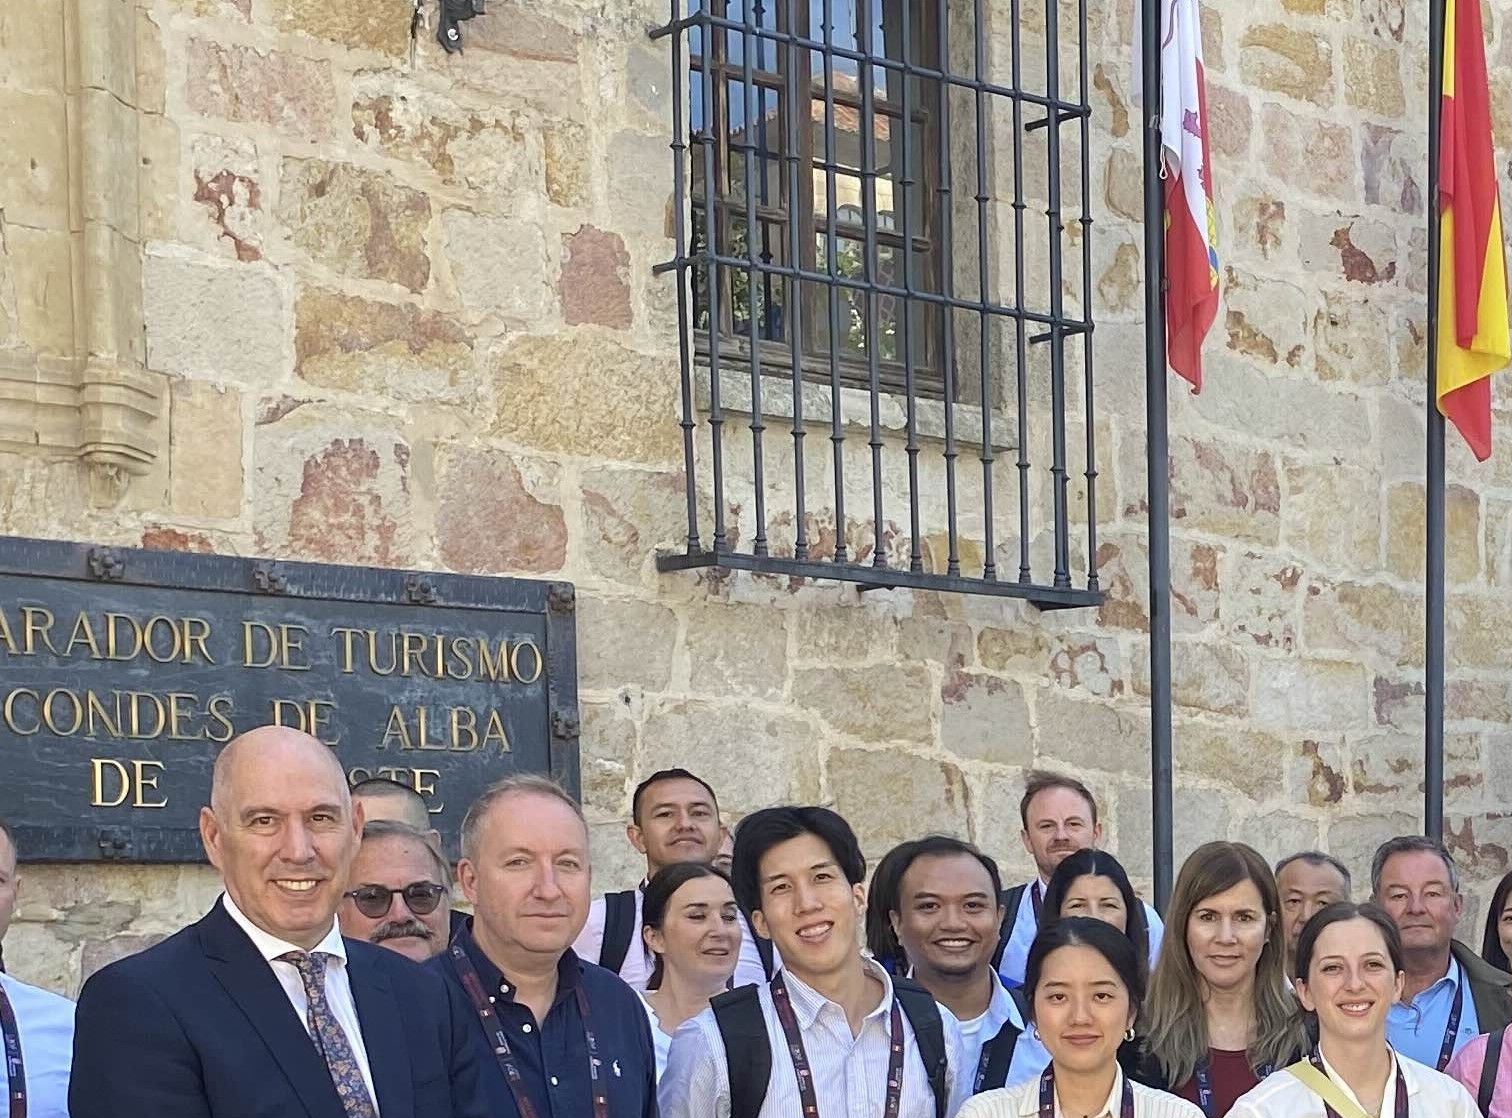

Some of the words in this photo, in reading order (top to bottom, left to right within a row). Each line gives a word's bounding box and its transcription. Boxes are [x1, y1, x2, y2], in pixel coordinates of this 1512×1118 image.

[242, 620, 311, 670] DE
[331, 626, 544, 685] TURISMO
[4, 687, 235, 742] CONDES
[272, 699, 342, 746] DE
[376, 703, 513, 754] ALBA
[90, 757, 168, 808] DE
